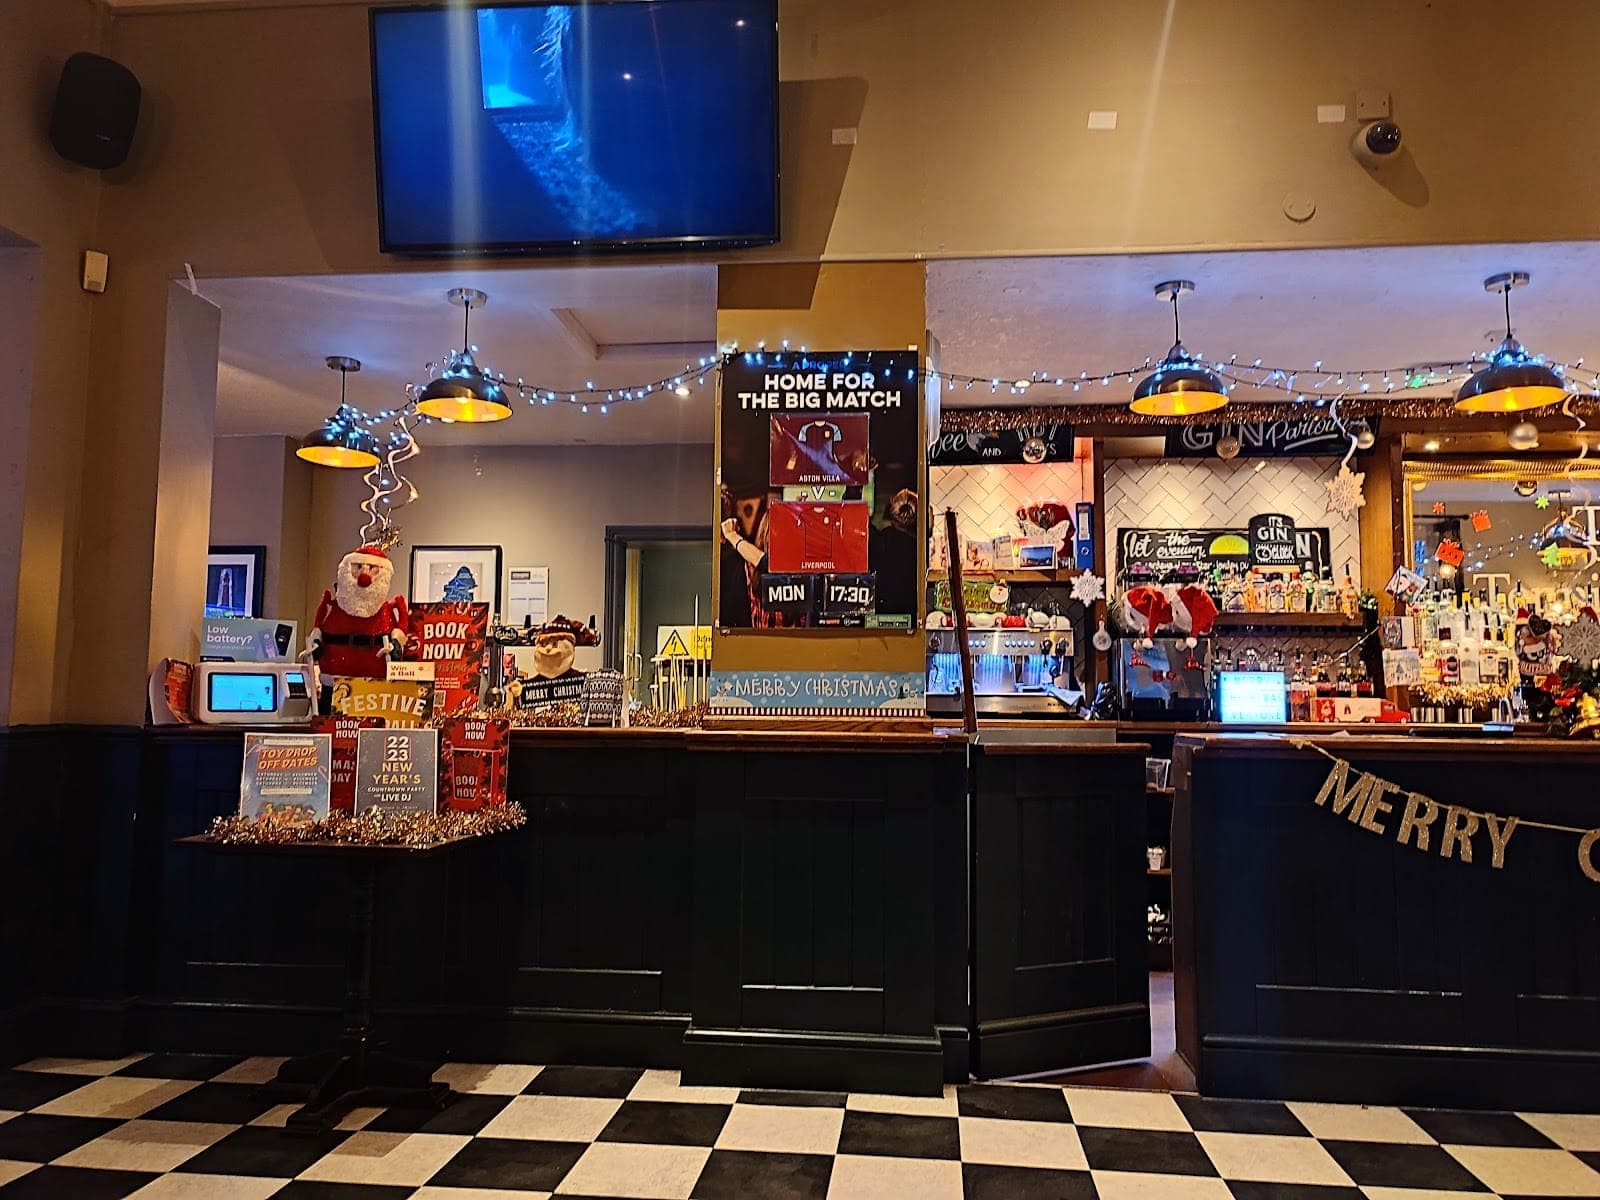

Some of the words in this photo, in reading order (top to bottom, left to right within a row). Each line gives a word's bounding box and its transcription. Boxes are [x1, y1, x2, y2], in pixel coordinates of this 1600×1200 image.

[764, 373, 827, 391] HOME
[832, 372, 875, 390] FOR
[738, 393, 779, 409] THE
[786, 392, 821, 408] BIG
[827, 391, 901, 408] MATCH
[982, 447, 1002, 457] AND
[822, 474, 841, 482] VILLA
[1257, 527, 1288, 541] GIN
[1129, 533, 1153, 559] let
[1165, 532, 1191, 545] the
[801, 562, 835, 570] LIVERPOOL
[768, 584, 805, 602] MON
[830, 585, 870, 603] 17:30
[207, 624, 229, 634] Low
[423, 622, 469, 640] BOOK
[206, 634, 253, 645] battery?
[422, 643, 465, 660] NOW
[525, 688, 549, 700] MERRY
[553, 684, 582, 697] CHRISTM
[735, 677, 801, 697] MERRY
[805, 677, 898, 698] CHRISTMAS
[341, 693, 427, 717] FESTIVE
[335, 721, 360, 730] BOOK
[465, 722, 486, 731] BOOK
[335, 730, 358, 738] NOW
[465, 731, 486, 740] NOW
[387, 736, 409, 748] 22
[261, 749, 285, 759] TOY
[285, 747, 317, 758] DROP
[387, 749, 408, 761] 23
[259, 760, 280, 769] OFF
[281, 757, 317, 769] DATES
[381, 763, 413, 772] NEW
[373, 774, 421, 784] YEAR'S
[401, 794, 411, 802] DJ
[1314, 758, 1521, 869] MERRY
